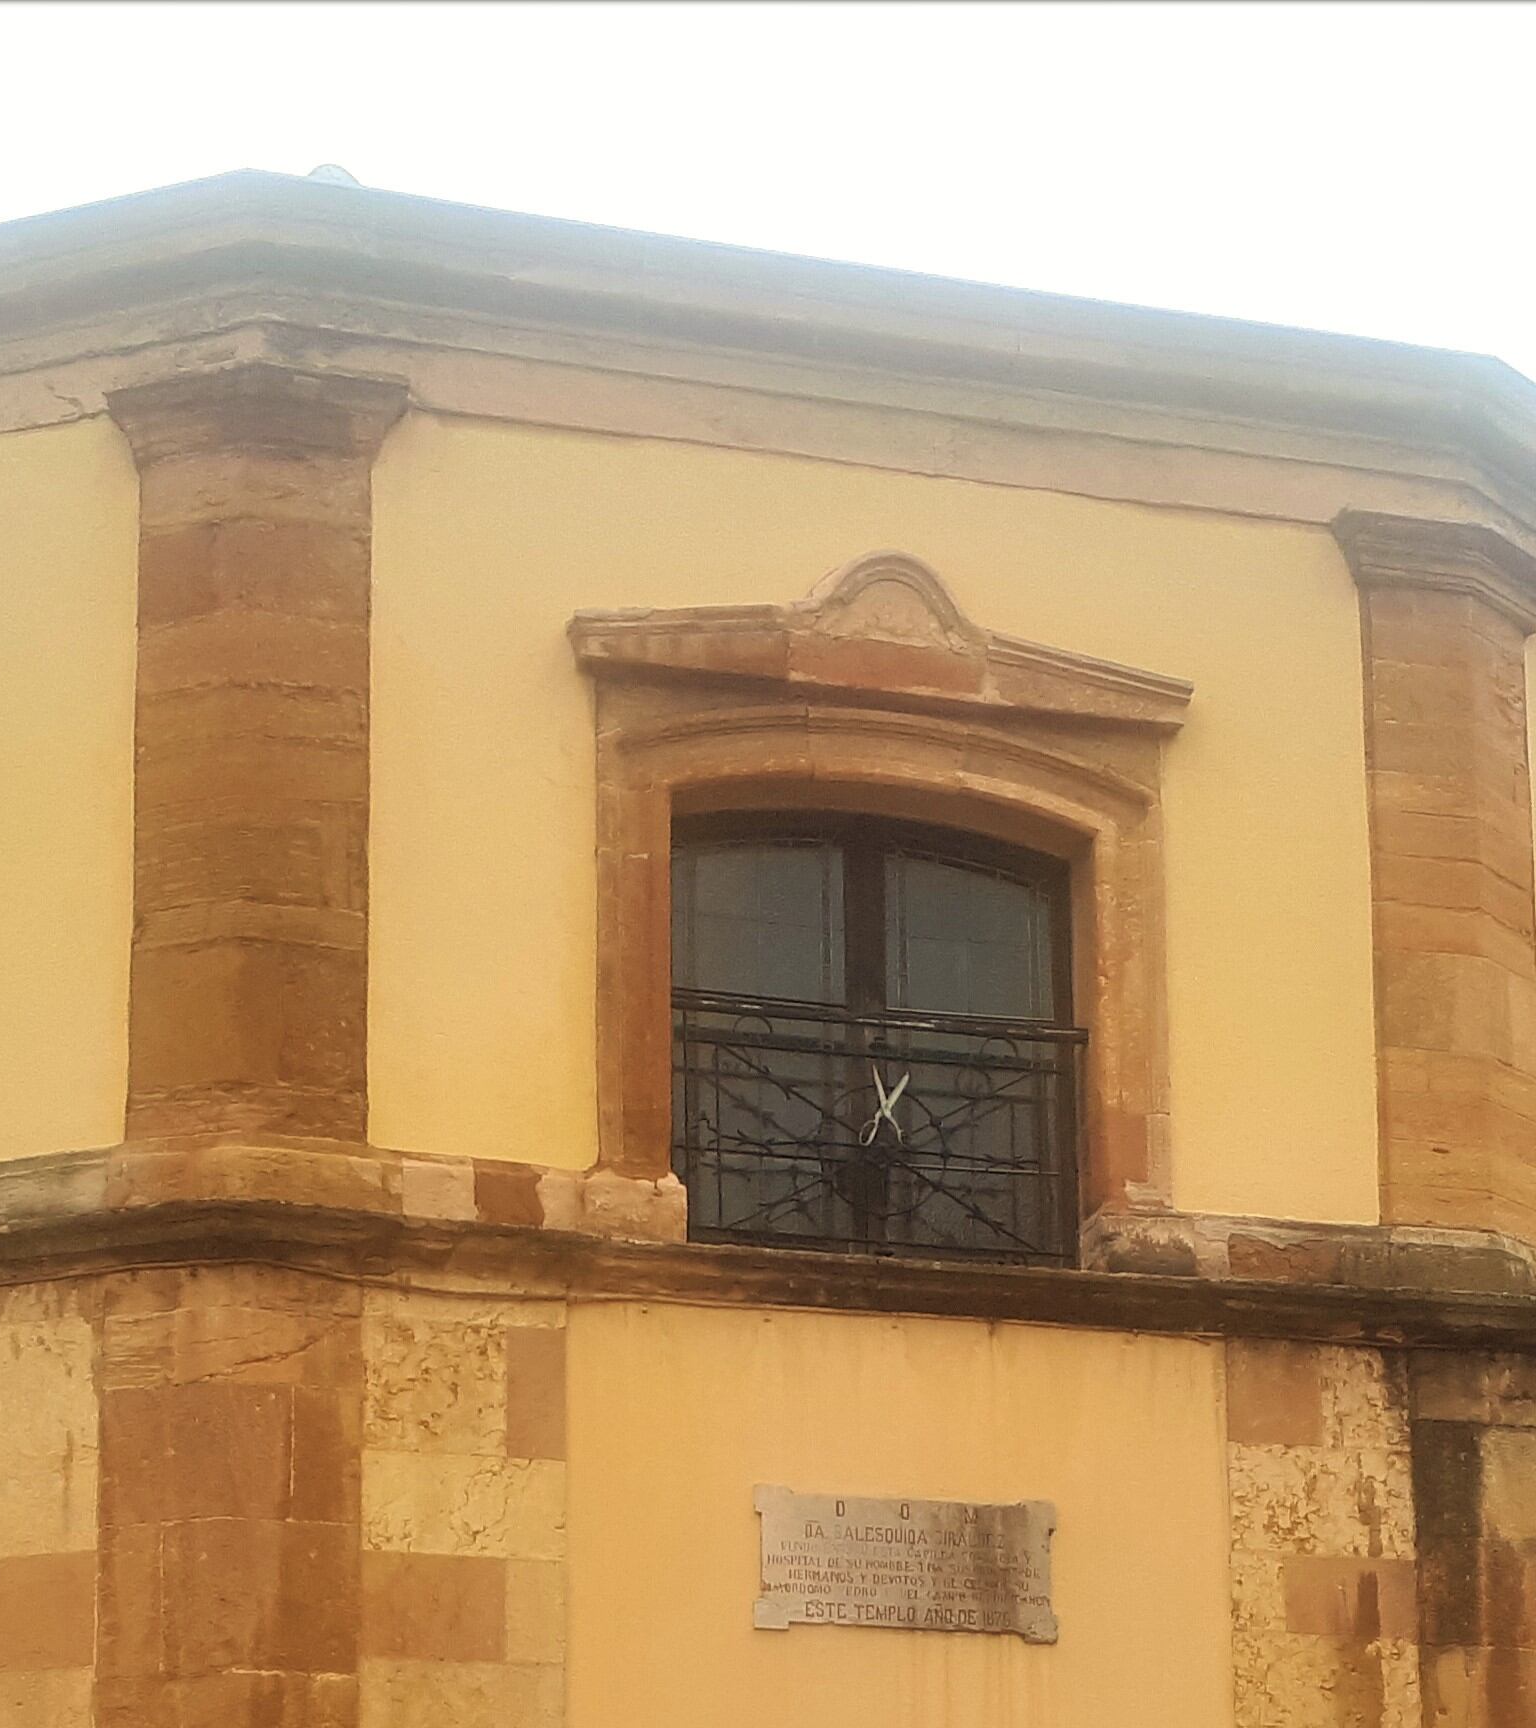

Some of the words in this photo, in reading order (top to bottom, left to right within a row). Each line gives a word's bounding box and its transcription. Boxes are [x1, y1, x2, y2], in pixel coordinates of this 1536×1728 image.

[767, 1554, 821, 1568] HOSPITAL
[788, 1568, 854, 1584] HERMANOS
[873, 1574, 925, 1587] DEVOTOS
[805, 1600, 847, 1619] ESTE
[854, 1603, 916, 1623] TEMPLO
